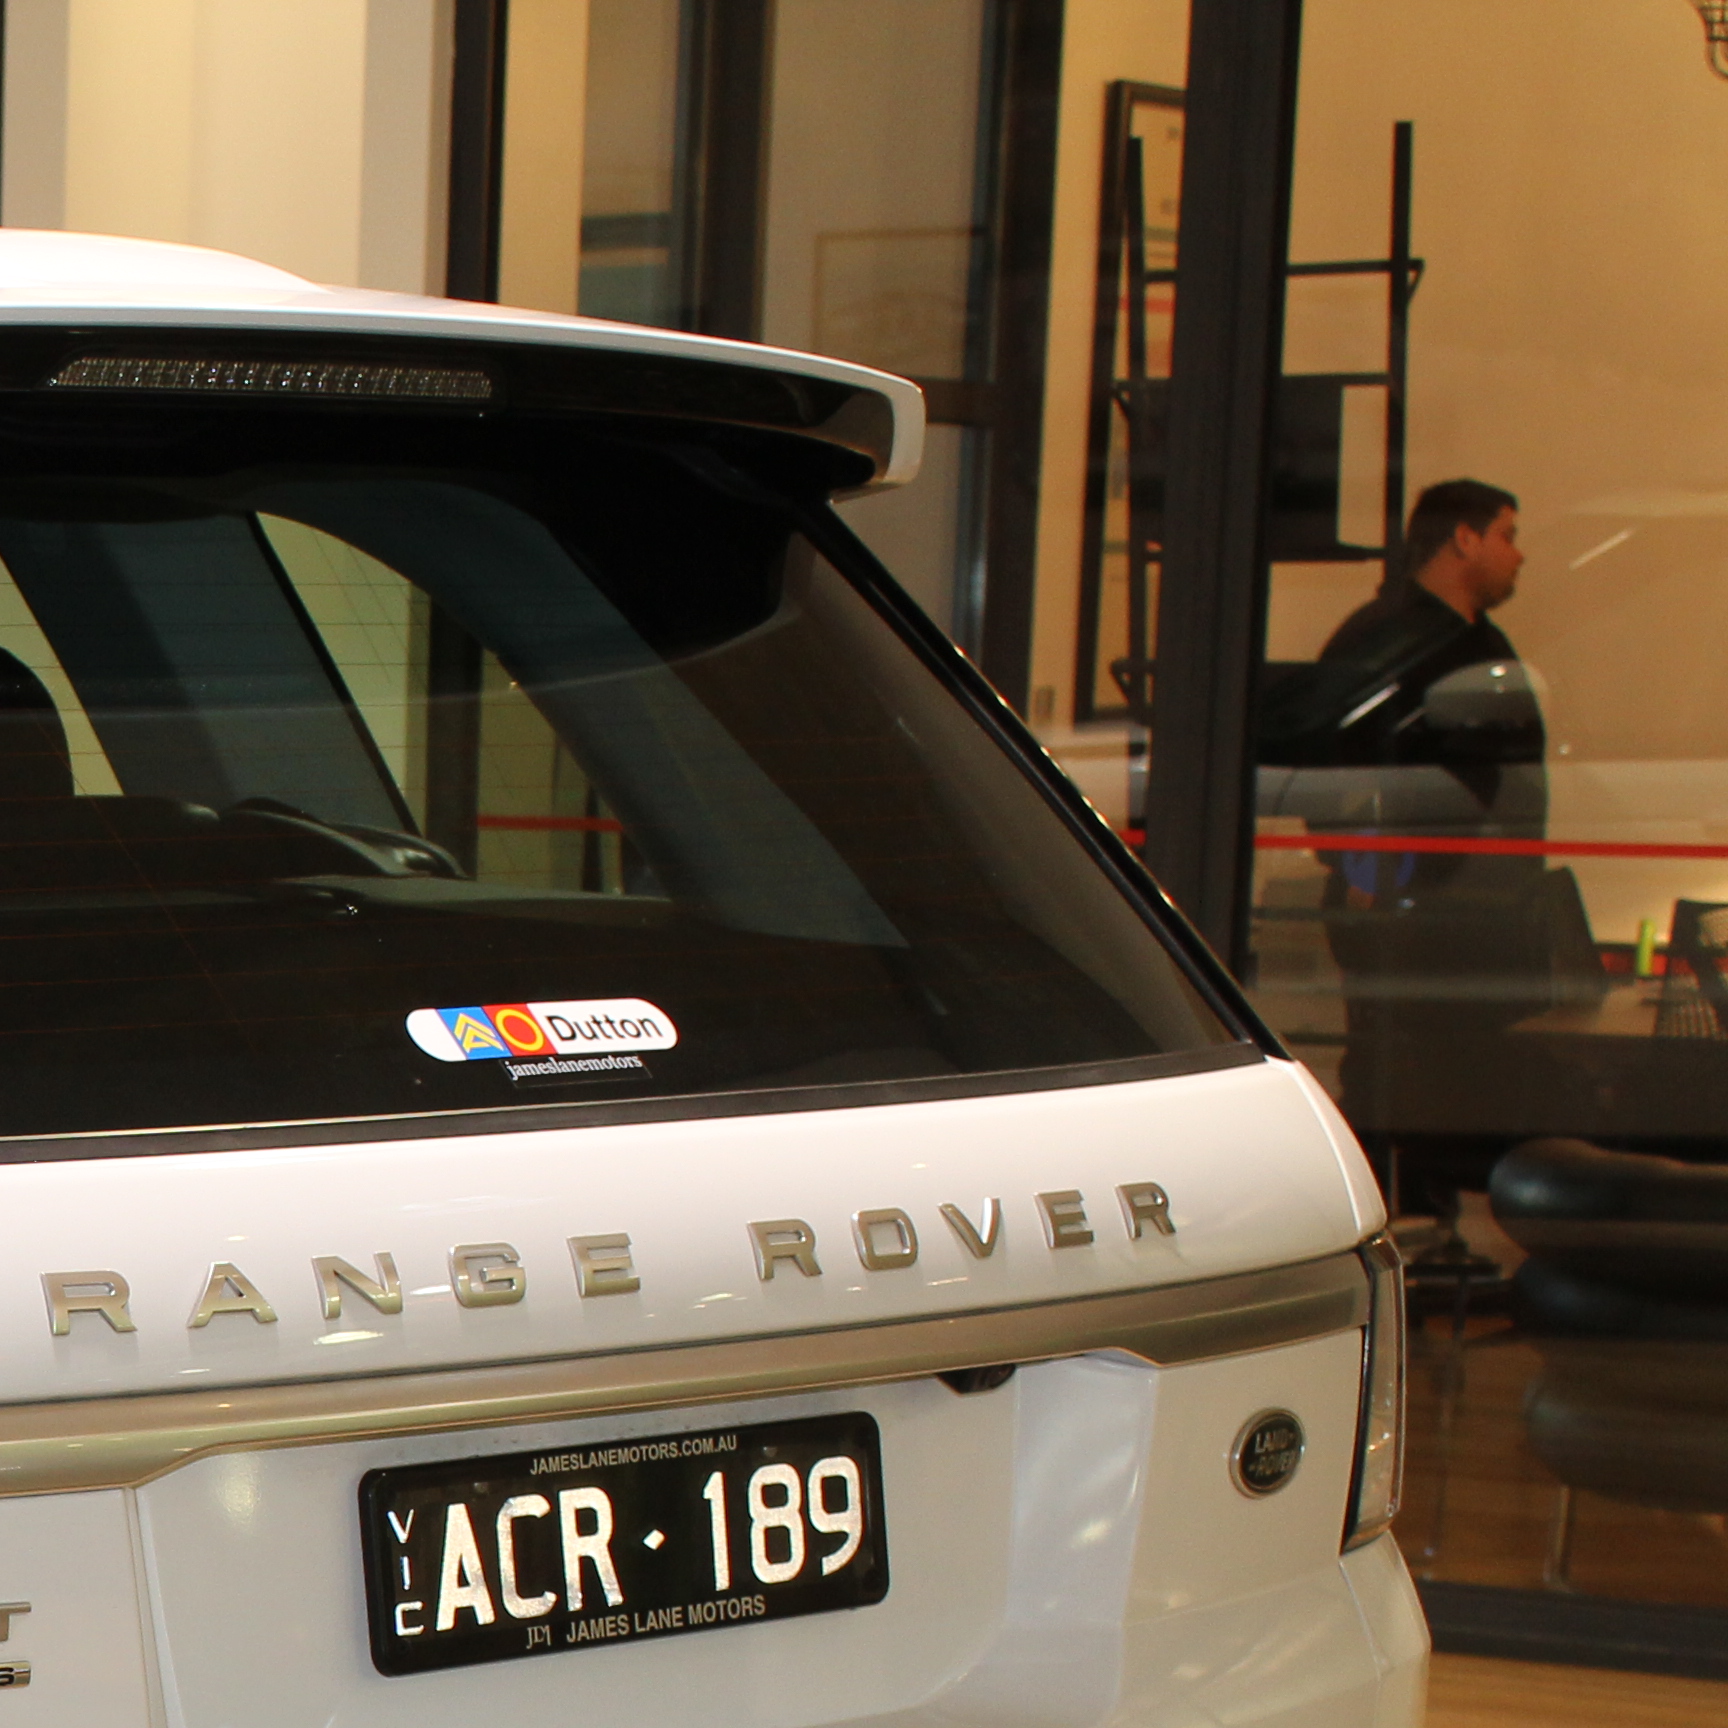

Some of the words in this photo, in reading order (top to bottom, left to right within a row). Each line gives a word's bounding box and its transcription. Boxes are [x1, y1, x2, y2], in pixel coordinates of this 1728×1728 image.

[545, 1013, 663, 1042] Dutton
[505, 1053, 643, 1081] jameslanemotors
[40, 1230, 643, 1338] RANGE
[746, 1180, 1178, 1281] ROVER
[529, 1435, 737, 1475] JAMESLANEMOTORS.COM.AU
[435, 1486, 624, 1631] ACR
[703, 1455, 863, 1591] 189
[387, 1508, 424, 1637] VIC
[566, 1611, 630, 1644] JAMES
[634, 1604, 684, 1636] LANE
[687, 1594, 766, 1629] MOTORS
